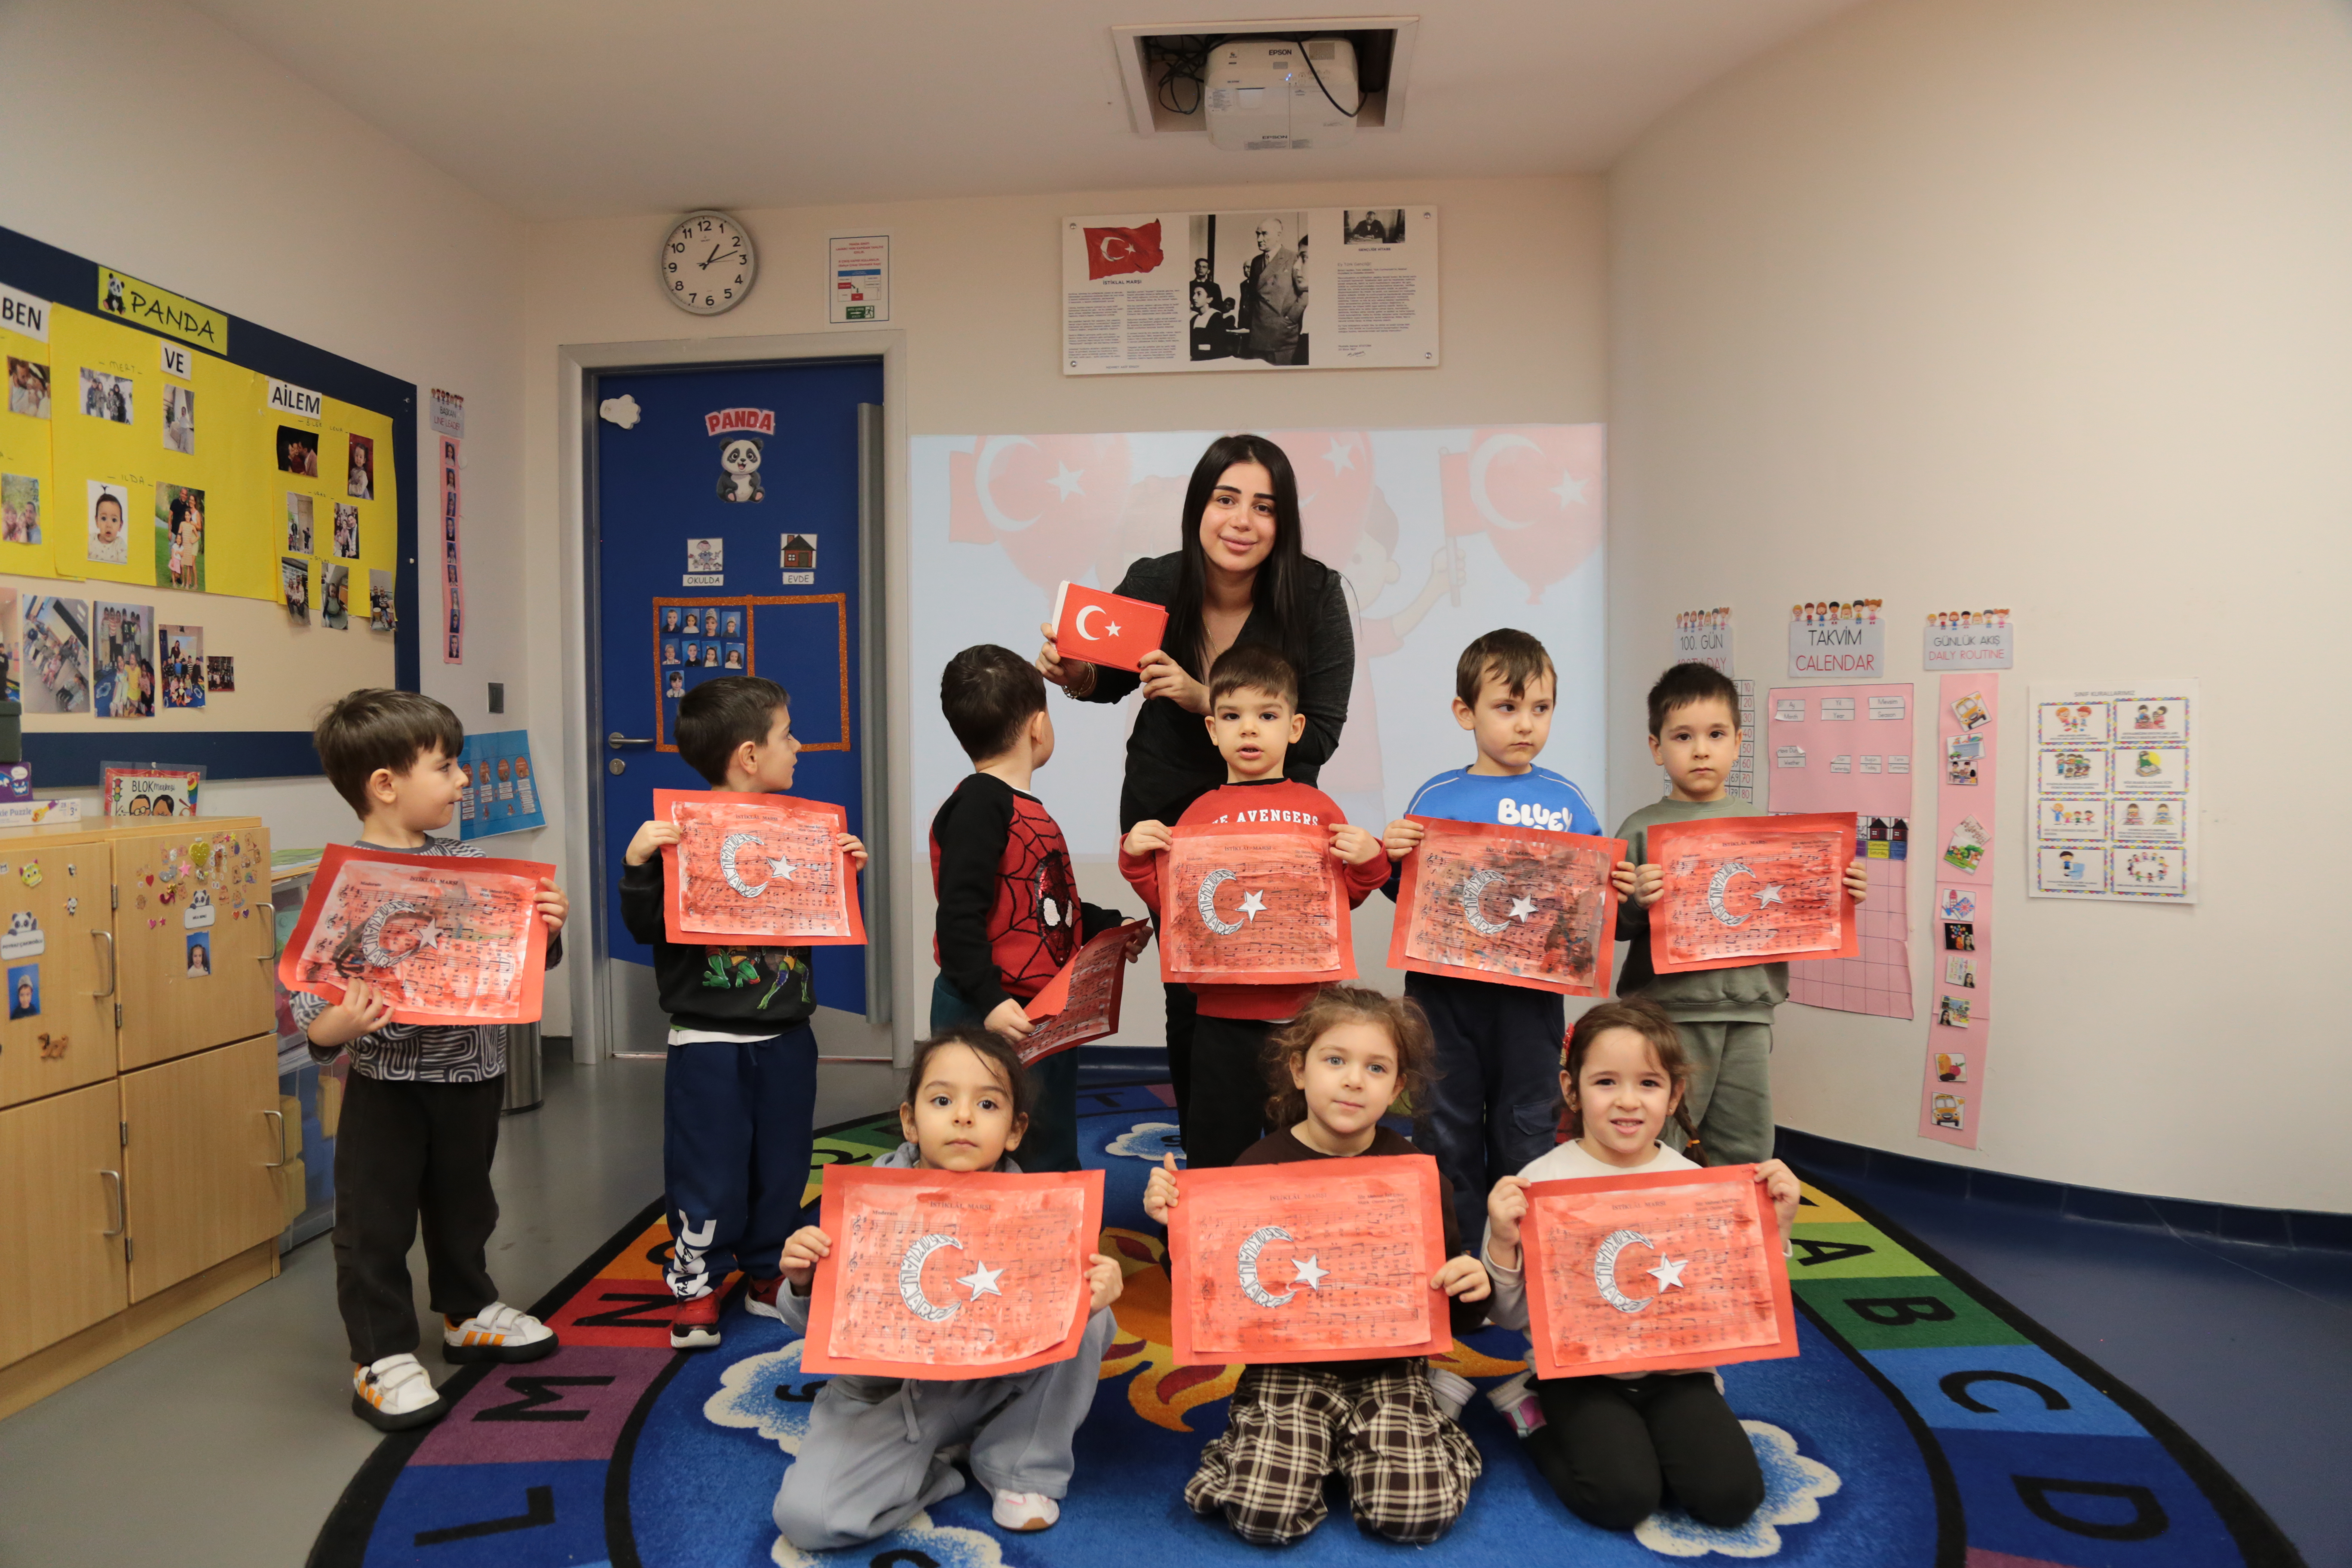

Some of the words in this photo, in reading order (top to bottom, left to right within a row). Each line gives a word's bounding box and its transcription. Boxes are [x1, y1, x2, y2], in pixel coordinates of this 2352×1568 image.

[697, 220, 712, 231] 12
[719, 223, 724, 233] 1
[682, 228, 692, 239] 11
[732, 236, 741, 247] 2
[671, 242, 685, 254] 10
[739, 254, 747, 265] 3
[668, 263, 677, 273] 9
[735, 274, 743, 285] 4
[675, 281, 684, 291] 8
[689, 293, 697, 303] 7
[724, 288, 732, 299] 5
[705, 296, 714, 306] 6
[2, 297, 42, 331] BEN
[131, 291, 214, 343] PANDA
[164, 347, 184, 374] VE
[110, 361, 135, 373] MERT
[272, 384, 320, 414] AİLEM
[708, 410, 772, 433] PANDA
[687, 576, 720, 585] OKULDA
[788, 575, 809, 583] EVDE
[1680, 636, 1697, 650] 100.
[1701, 631, 1723, 649] GÜN
[1808, 626, 1862, 647] TAKVİM
[1933, 635, 1975, 647] GÜNLÜK
[1980, 635, 2000, 648] AKIŞ
[1929, 649, 1956, 661] DAILY
[1960, 649, 2004, 660] ROUTINE
[1796, 654, 1874, 672] CALENDAR
[1744, 683, 1751, 692] 10
[1743, 698, 1752, 707] 20
[1743, 713, 1752, 723] 30
[1743, 729, 1752, 738] 40
[1743, 744, 1751, 753] 50
[1742, 759, 1751, 768] 60
[1731, 774, 1739, 782] 69
[1742, 774, 1750, 783] 70
[132, 780, 154, 792] BLOK
[1742, 790, 1750, 799] 80
[10, 808, 32, 816] Puzzle
[1237, 809, 1318, 826] AVENGERS
[1498, 797, 1573, 832] BLUEY
[1789, 1238, 1876, 1266] A
[572, 1292, 678, 1328] N
[1843, 1295, 1957, 1326] B
[1938, 1369, 2072, 1413] C
[469, 1375, 617, 1422] M
[2009, 1474, 2170, 1541] D
[413, 1484, 556, 1547] L
